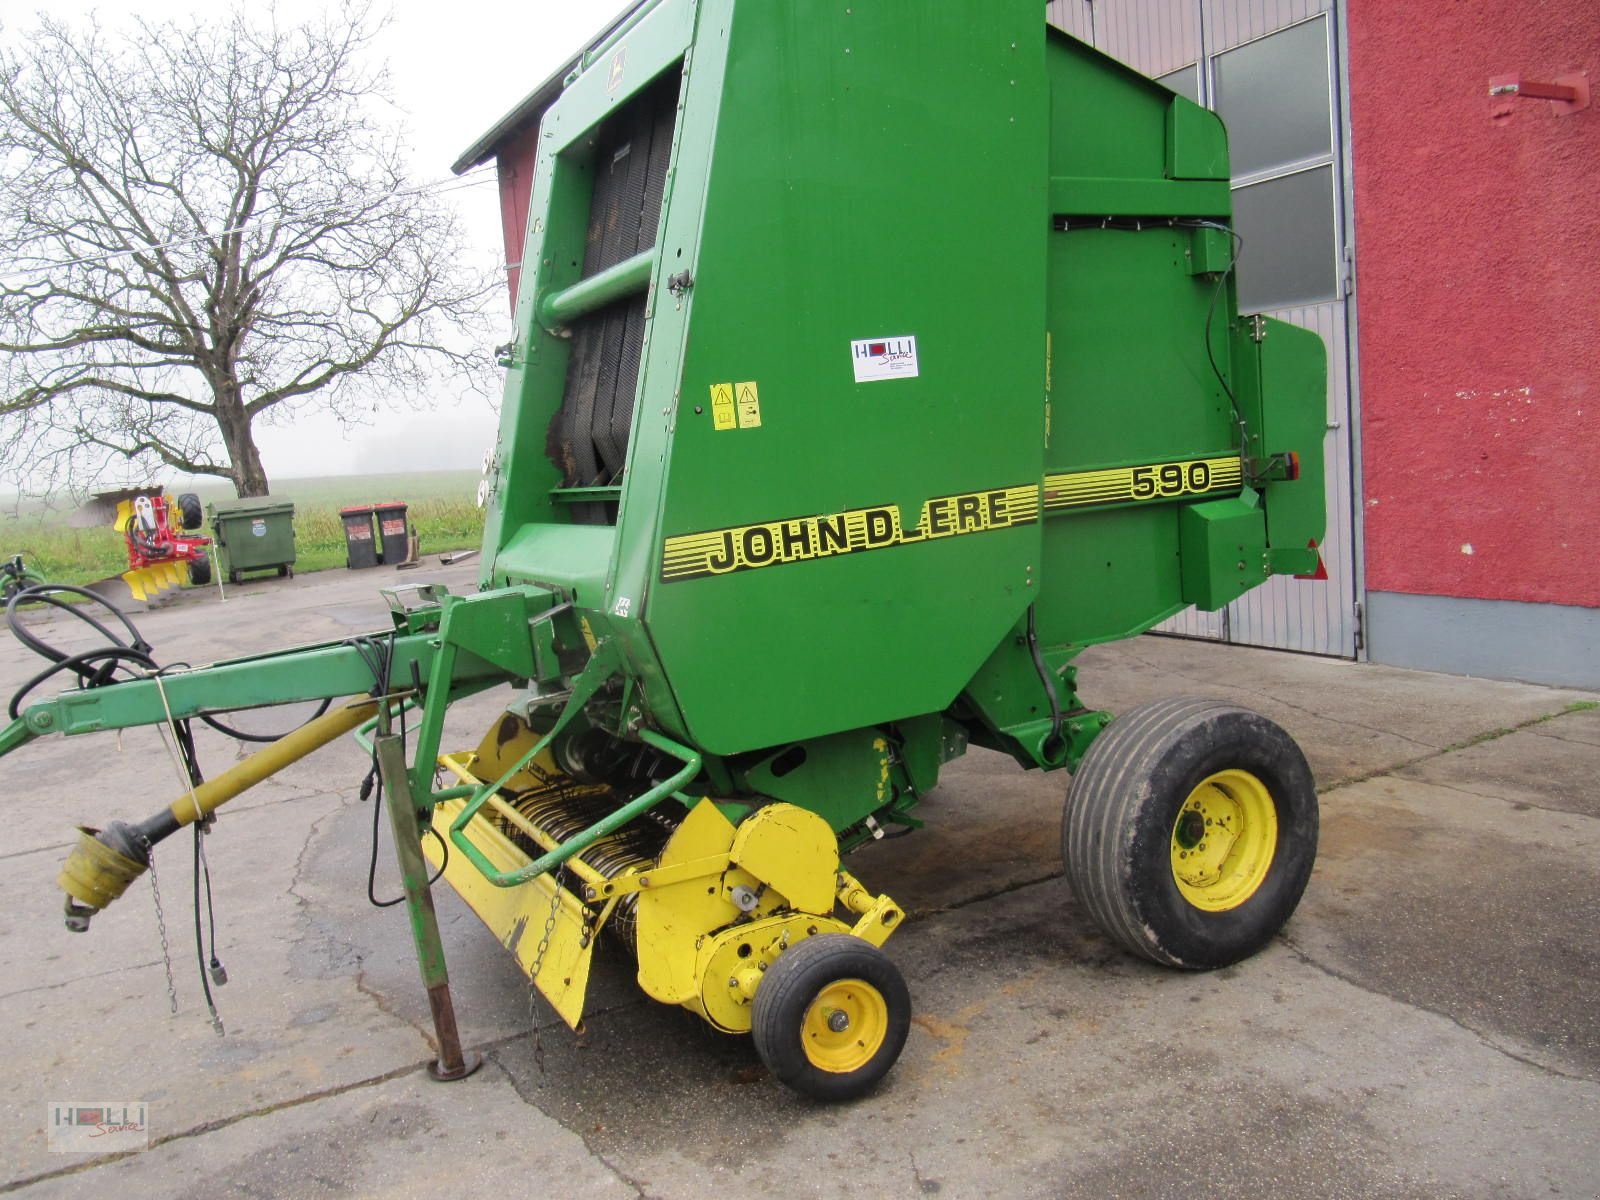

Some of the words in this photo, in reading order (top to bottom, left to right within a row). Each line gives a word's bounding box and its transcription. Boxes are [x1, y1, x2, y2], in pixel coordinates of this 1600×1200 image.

[855, 340, 913, 359] HOLLI
[1132, 462, 1211, 499] 590
[707, 517, 850, 573] JOHN
[866, 492, 1011, 547] DERE
